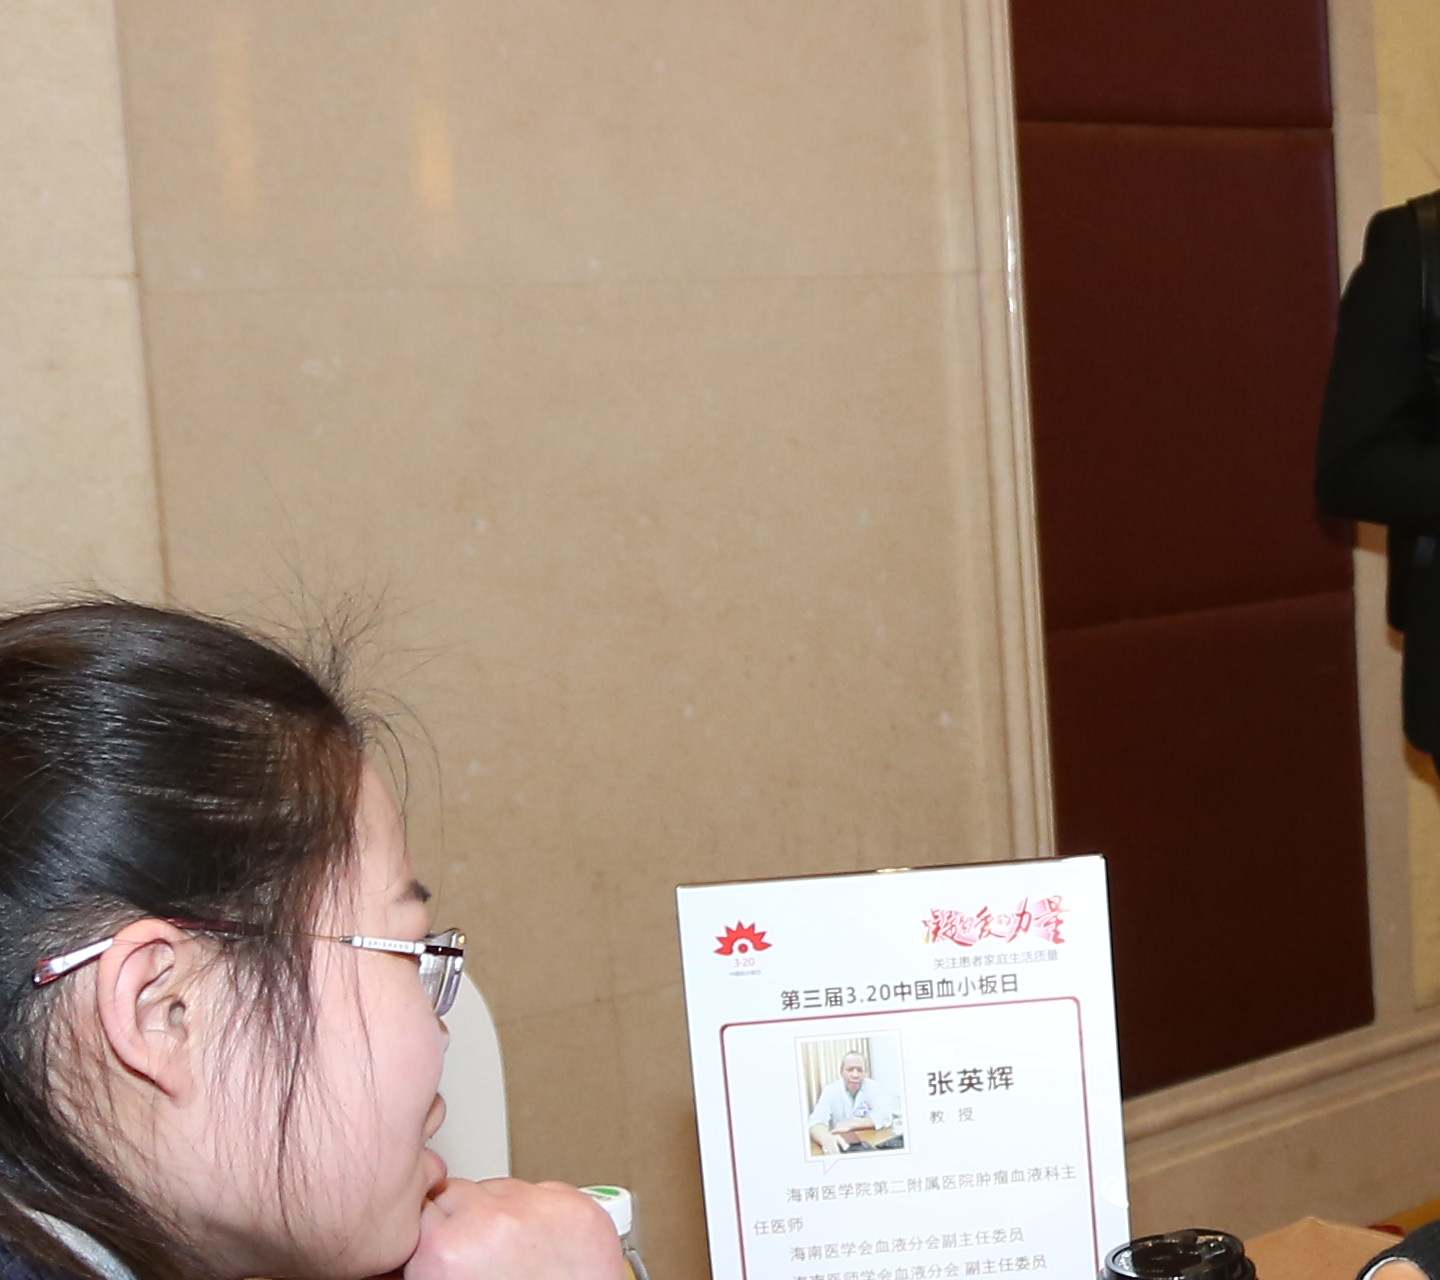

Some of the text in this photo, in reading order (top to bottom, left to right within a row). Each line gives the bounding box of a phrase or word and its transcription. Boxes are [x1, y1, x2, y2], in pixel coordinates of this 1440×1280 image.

[780, 973, 1020, 1011] 第三届3.20中国血小板日
[927, 1066, 1014, 1096] 张英辉
[786, 1165, 1077, 1204] 海南医学院第二附属医院肿瘤血液科主
[753, 1217, 804, 1236] 任医师
[790, 1227, 1025, 1262] 海南医学会血液分会副主任委员
